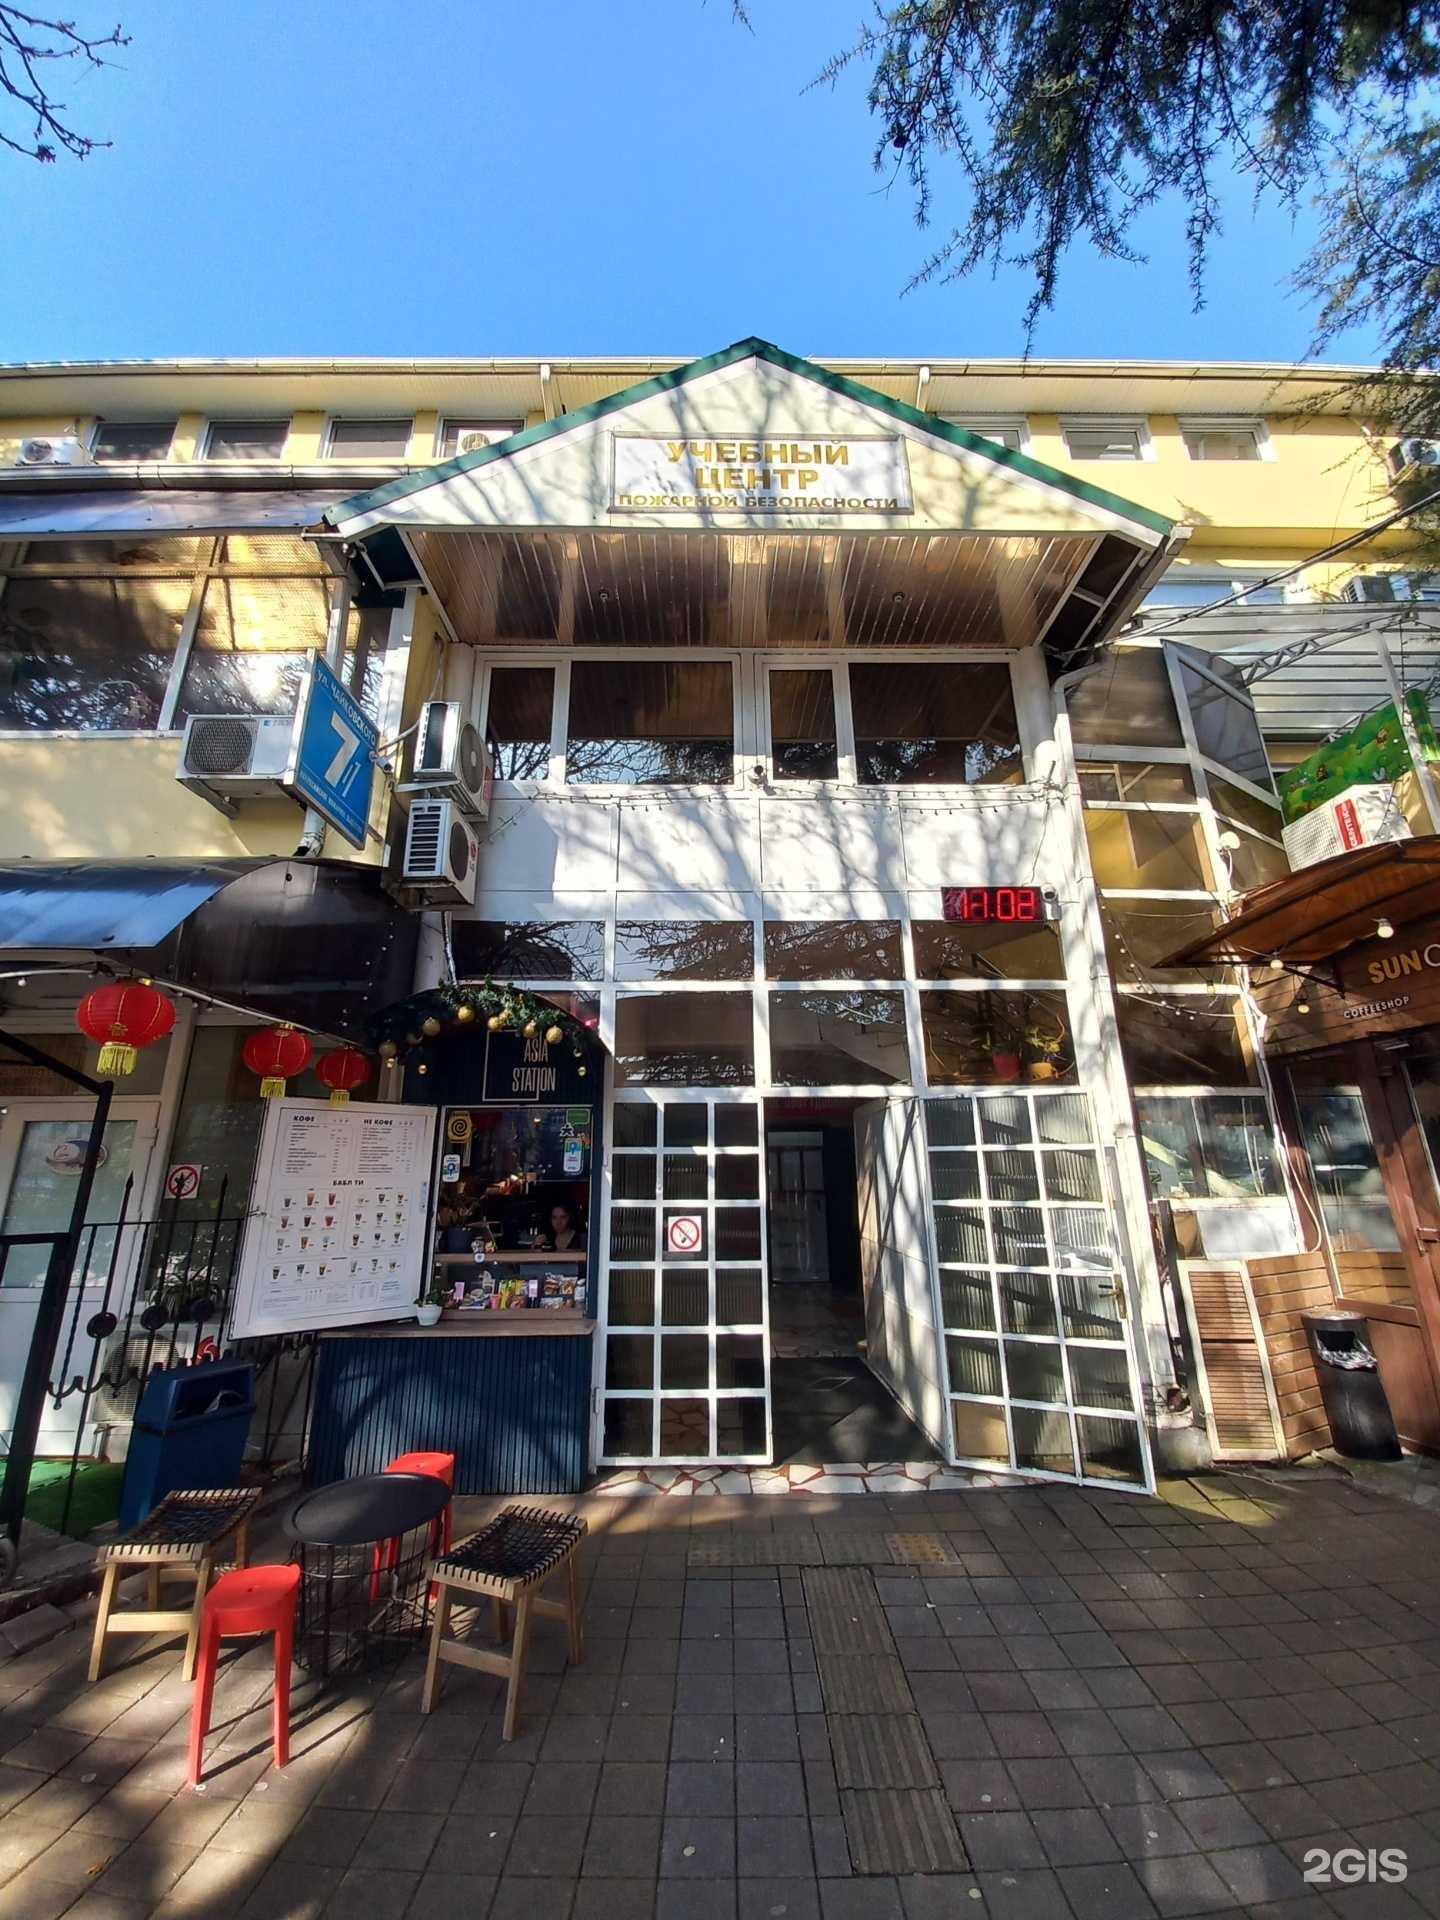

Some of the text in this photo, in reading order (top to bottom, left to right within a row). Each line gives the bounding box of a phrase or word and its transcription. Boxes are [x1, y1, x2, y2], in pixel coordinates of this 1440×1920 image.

[667, 440, 849, 465] УЧЕБНЫЙ
[695, 468, 819, 492] ЦЕНТР
[619, 494, 898, 509] ПОЖАРНОЙ БЕЗОПАСНОСТИ
[330, 682, 376, 746] ЧАЙКОВСКОГО
[1344, 996, 1409, 1018] COFFEESHOP
[524, 1039, 548, 1062] ASIA
[512, 1067, 556, 1091] STATION
